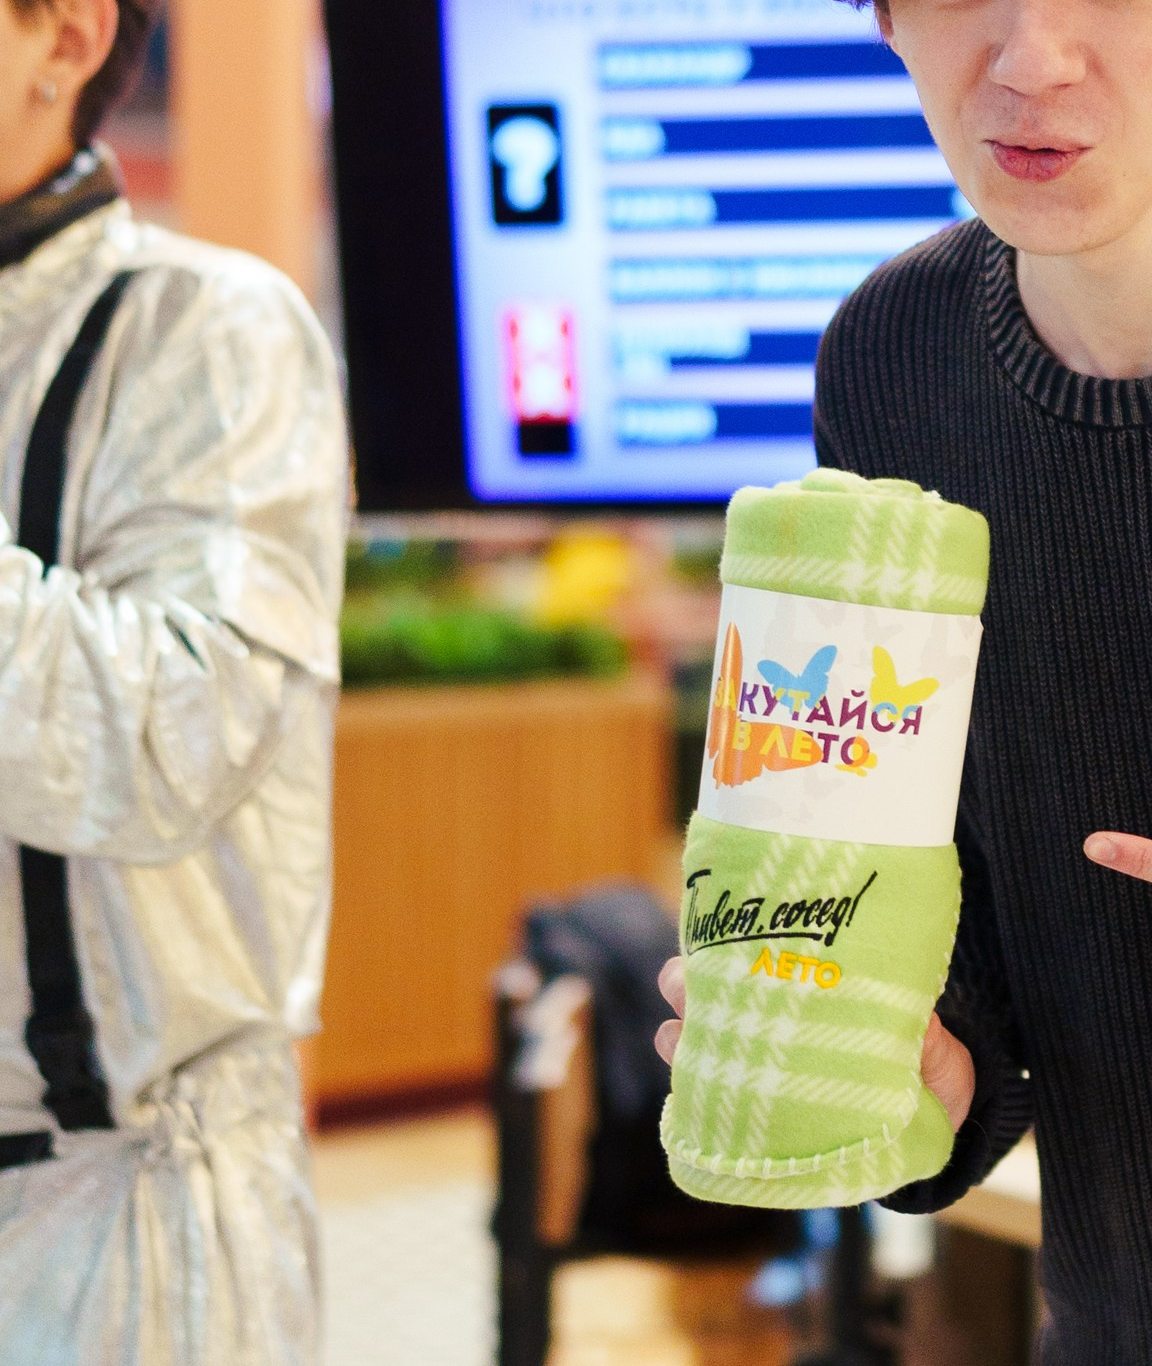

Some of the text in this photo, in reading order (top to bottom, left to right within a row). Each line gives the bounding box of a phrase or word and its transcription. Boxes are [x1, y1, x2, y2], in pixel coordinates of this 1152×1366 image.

[732, 717, 870, 767] В ЛЕТО
[769, 870, 878, 947] сосед!
[751, 946, 842, 989] ЛЕТО
